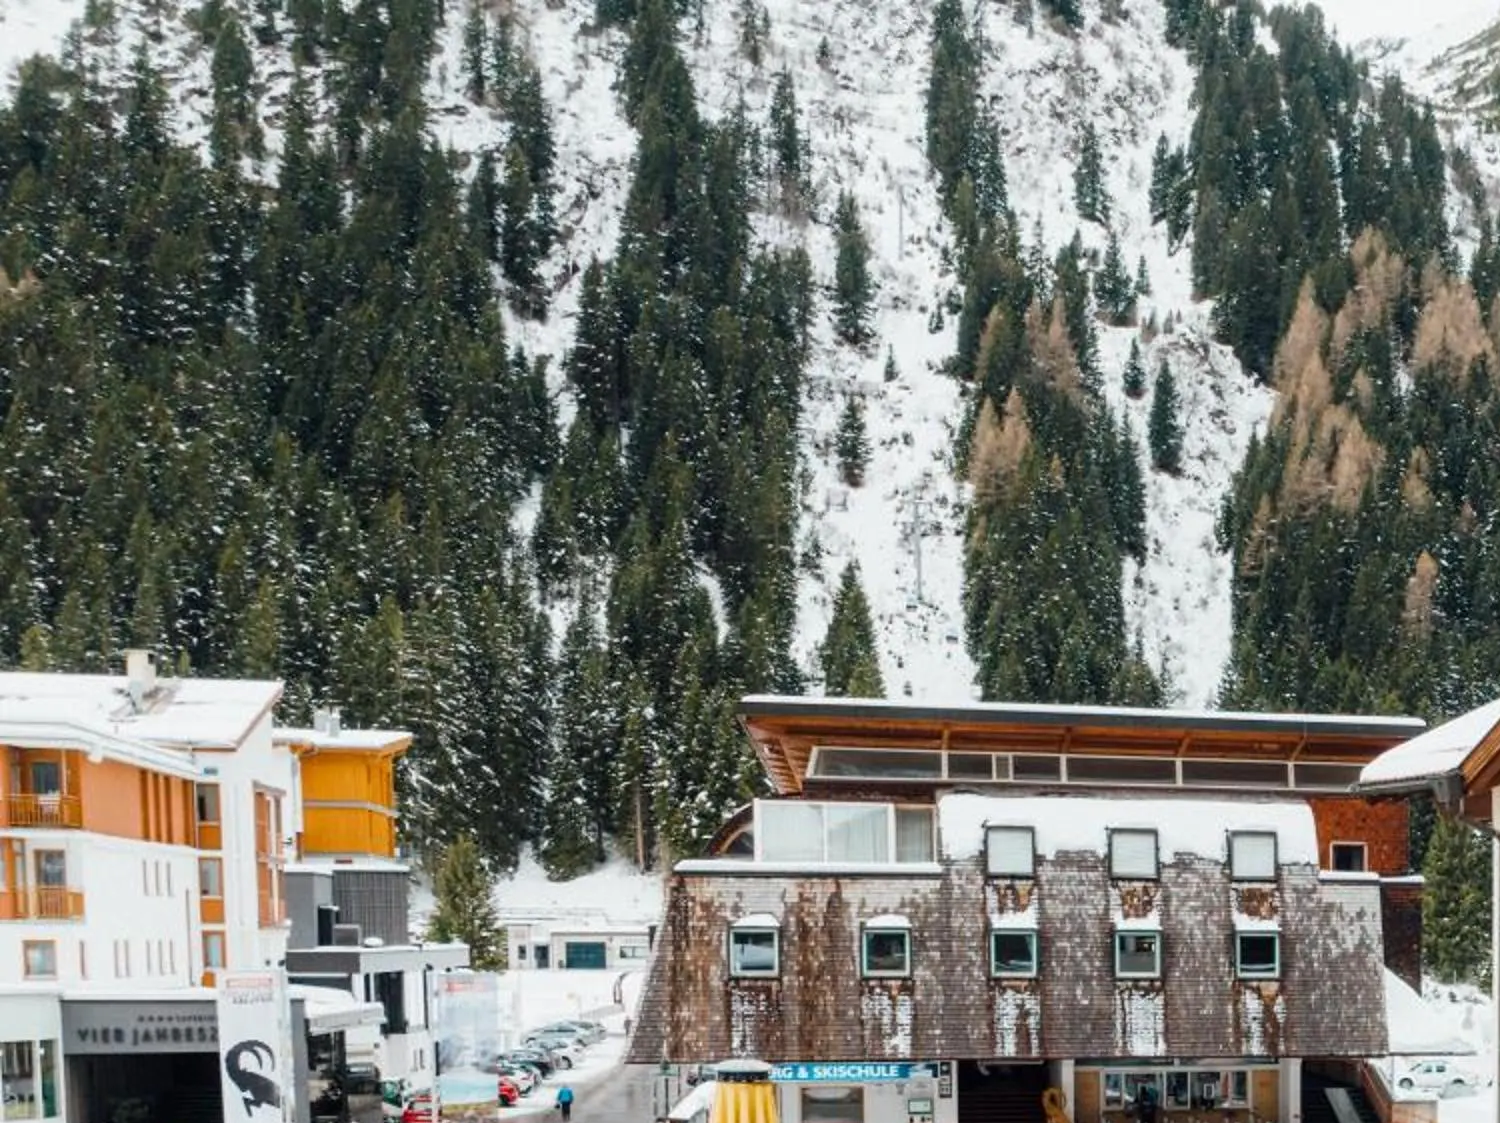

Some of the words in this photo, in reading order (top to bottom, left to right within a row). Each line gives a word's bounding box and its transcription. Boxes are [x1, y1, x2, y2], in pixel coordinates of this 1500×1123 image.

[77, 1027, 124, 1043] VIER
[798, 1066, 809, 1079] &
[814, 1065, 900, 1079] SKISCHULE
